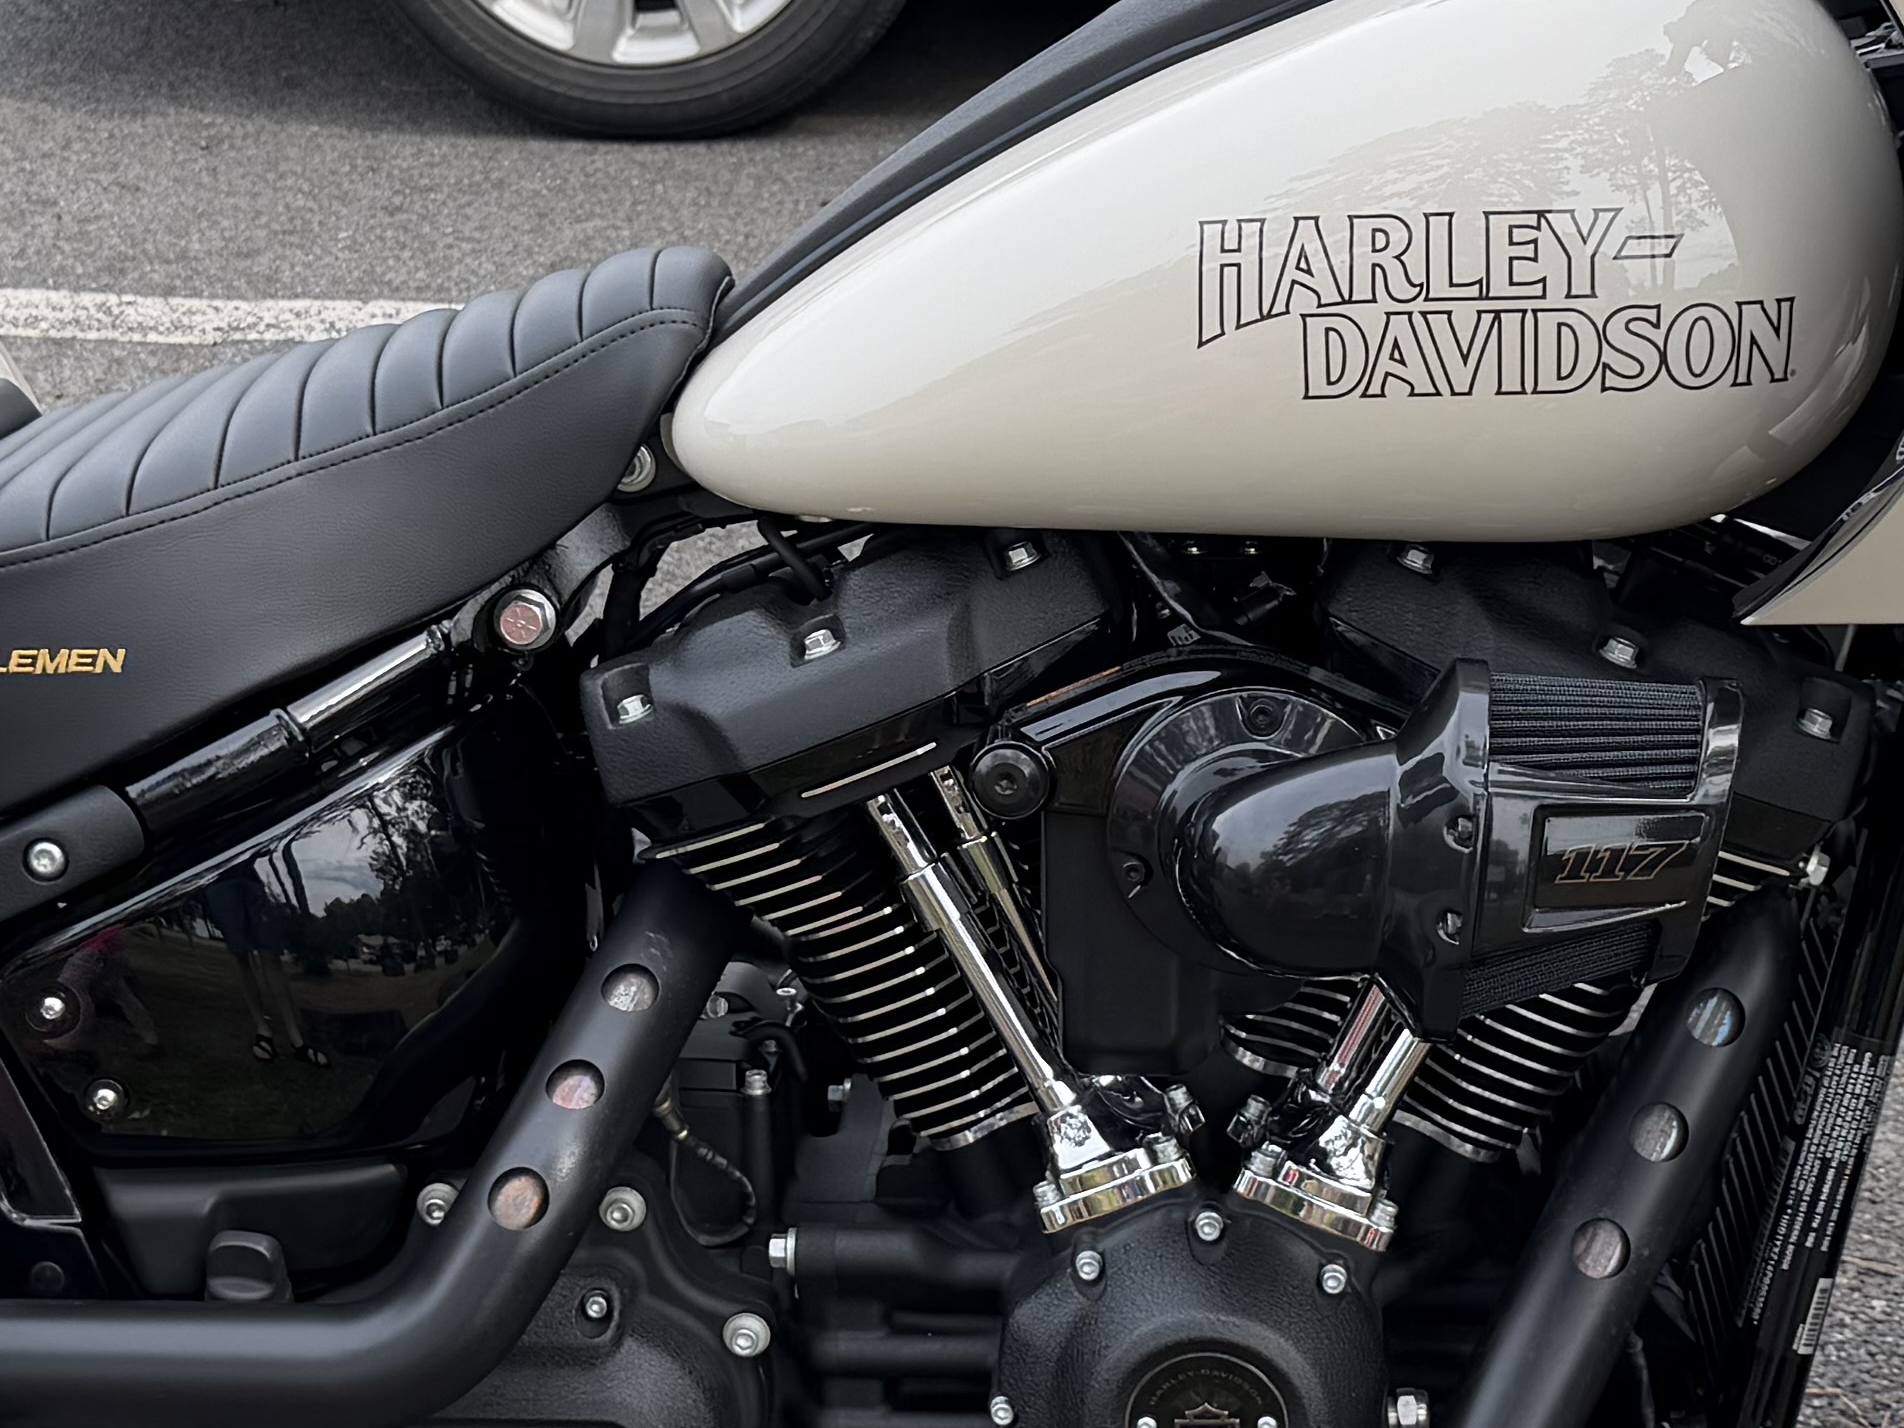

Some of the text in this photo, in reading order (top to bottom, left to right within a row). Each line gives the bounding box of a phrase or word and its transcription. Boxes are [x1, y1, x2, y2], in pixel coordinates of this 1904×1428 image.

[1198, 207, 1683, 349] HARLEY-
[1301, 297, 1795, 400] DAVIDSON
[1555, 839, 1694, 887] 117
